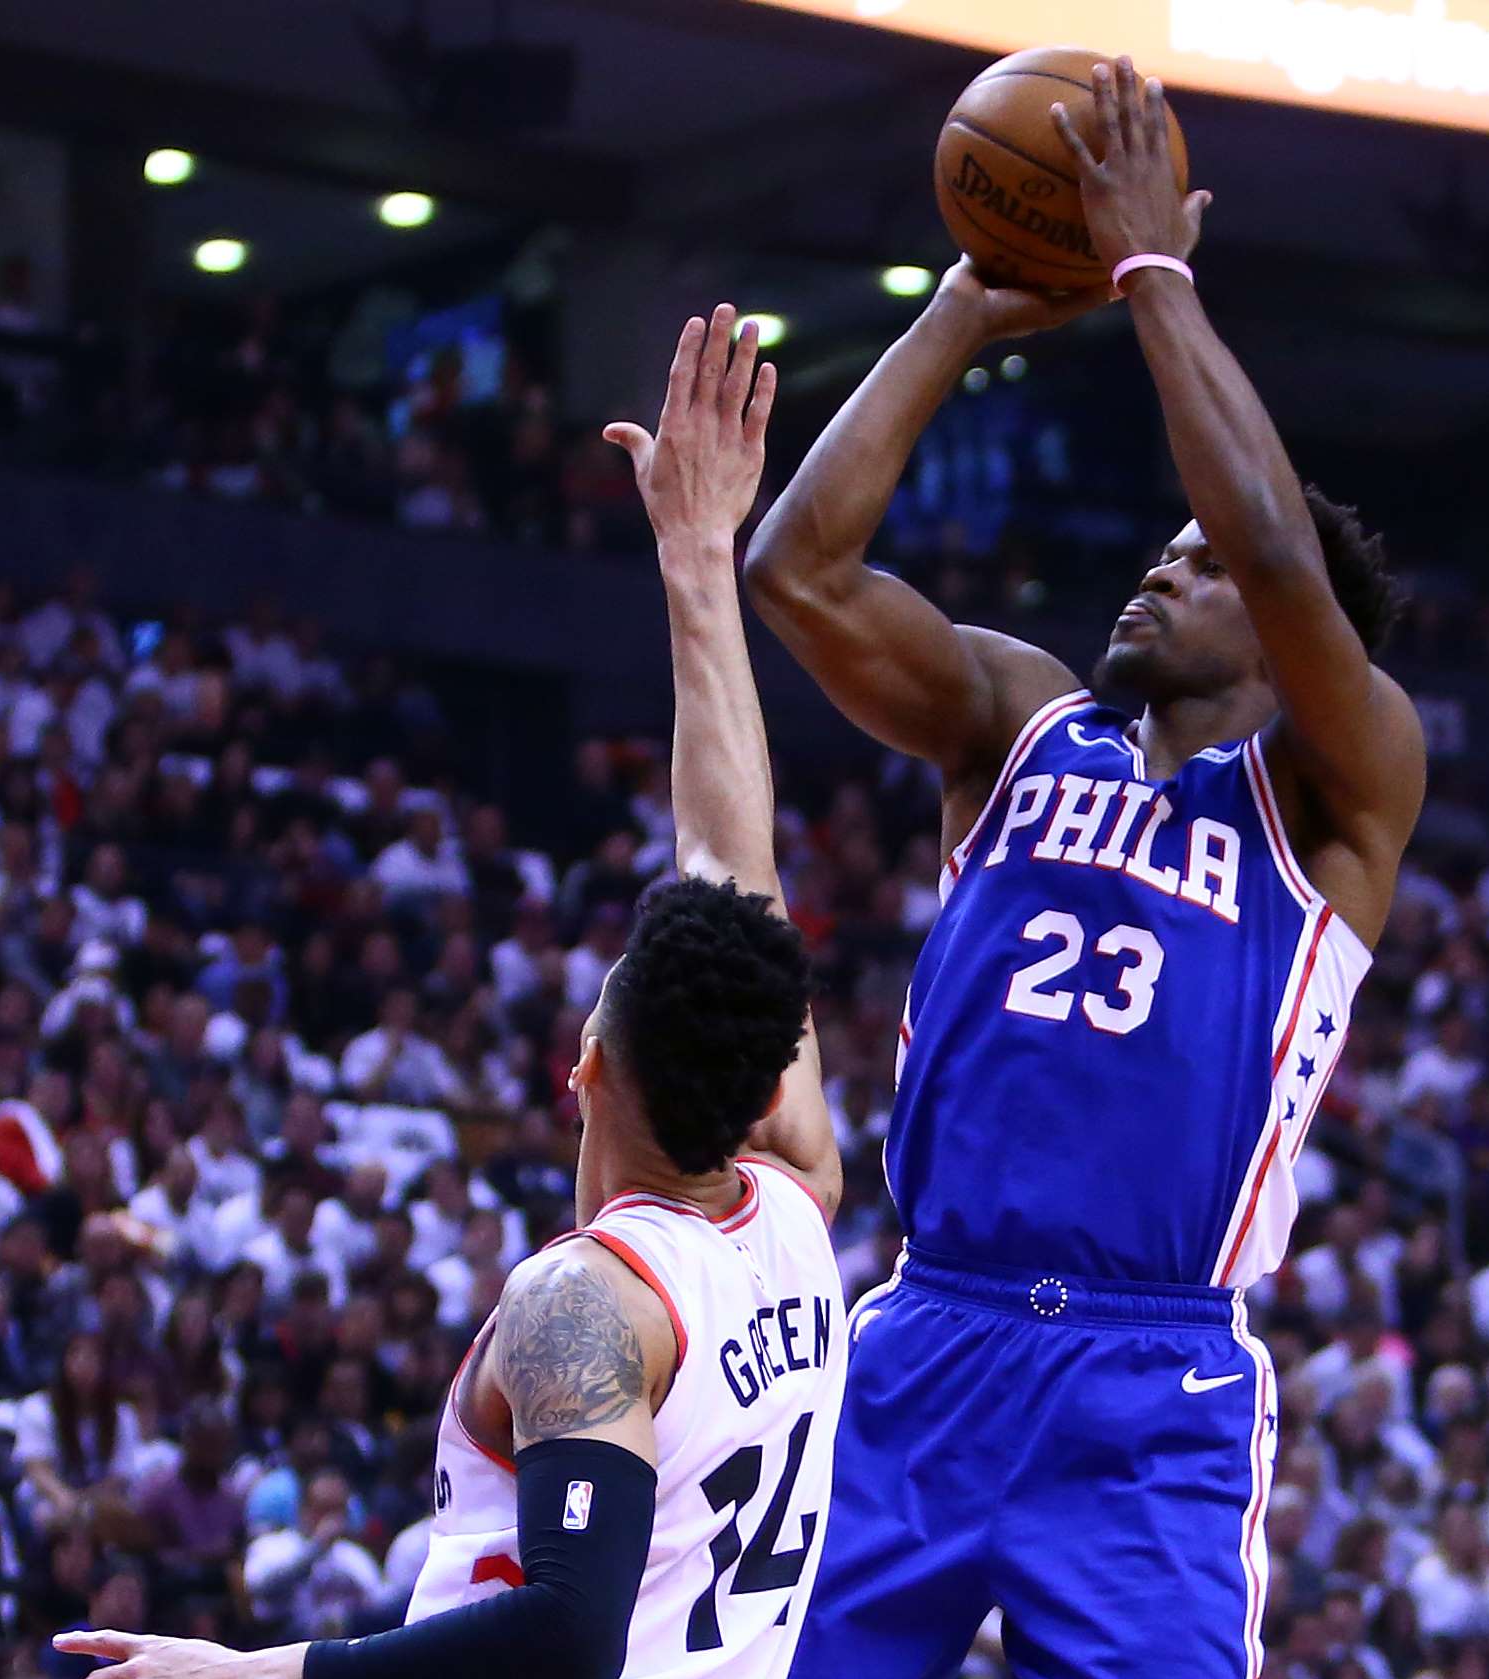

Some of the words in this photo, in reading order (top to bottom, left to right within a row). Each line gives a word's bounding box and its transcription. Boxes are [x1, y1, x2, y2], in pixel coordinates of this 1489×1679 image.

[953, 152, 1100, 262] SPALDIN
[984, 774, 1242, 925] PHILA
[1004, 909, 1165, 1036] 23
[720, 1296, 831, 1408] GREEN
